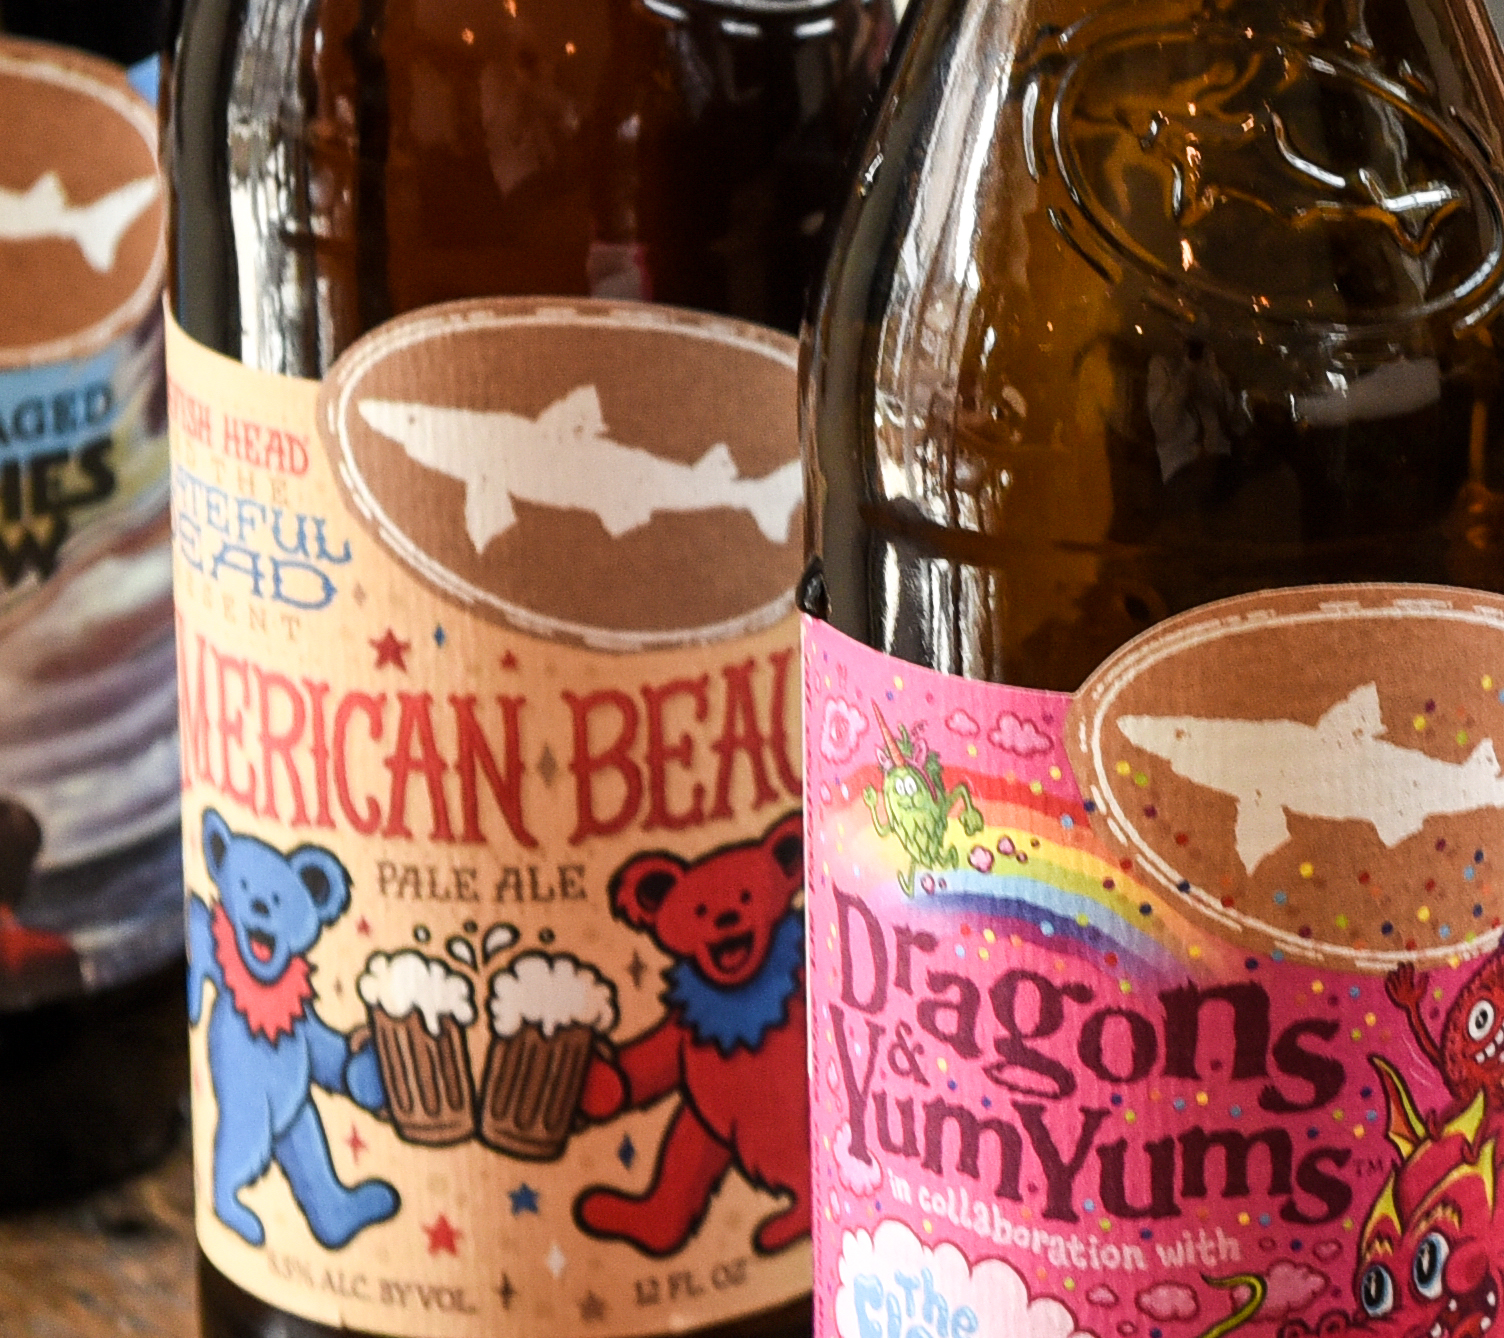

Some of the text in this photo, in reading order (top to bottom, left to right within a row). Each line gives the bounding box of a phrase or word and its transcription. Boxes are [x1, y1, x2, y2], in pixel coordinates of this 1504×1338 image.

[224, 413, 309, 477] HEAD
[178, 511, 337, 610] EAD
[177, 609, 538, 850] MERICAN
[377, 861, 587, 903] PALE ALE
[834, 891, 1346, 1113] Dragons
[889, 1023, 929, 1086] &
[830, 1004, 1353, 1224] YumYums
[889, 1168, 1240, 1271] in collaboration with
[379, 1279, 412, 1307] BY
[635, 1276, 660, 1307] 12
